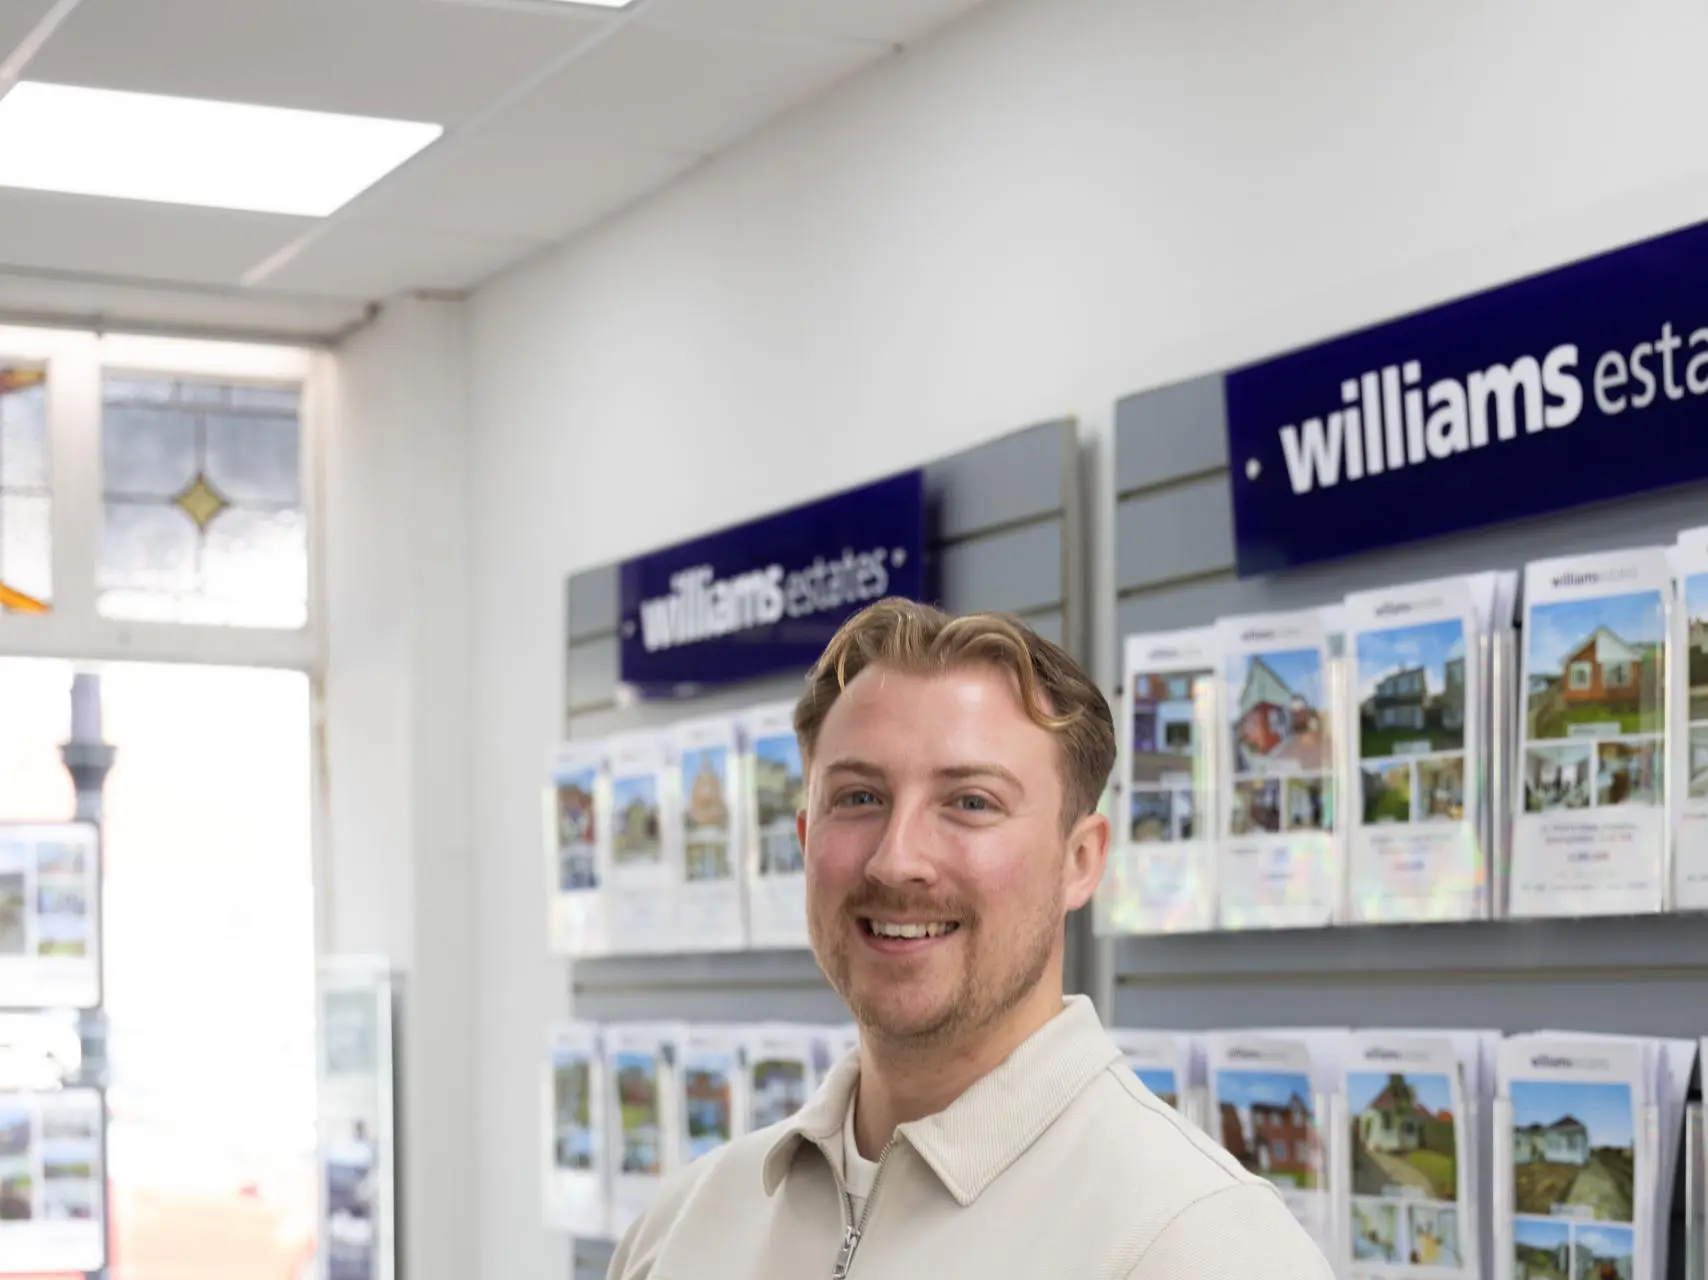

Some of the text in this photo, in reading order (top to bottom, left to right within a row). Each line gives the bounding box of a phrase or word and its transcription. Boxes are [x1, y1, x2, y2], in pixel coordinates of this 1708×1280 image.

[1279, 344, 1584, 495] williams
[640, 547, 889, 653] williams estates
